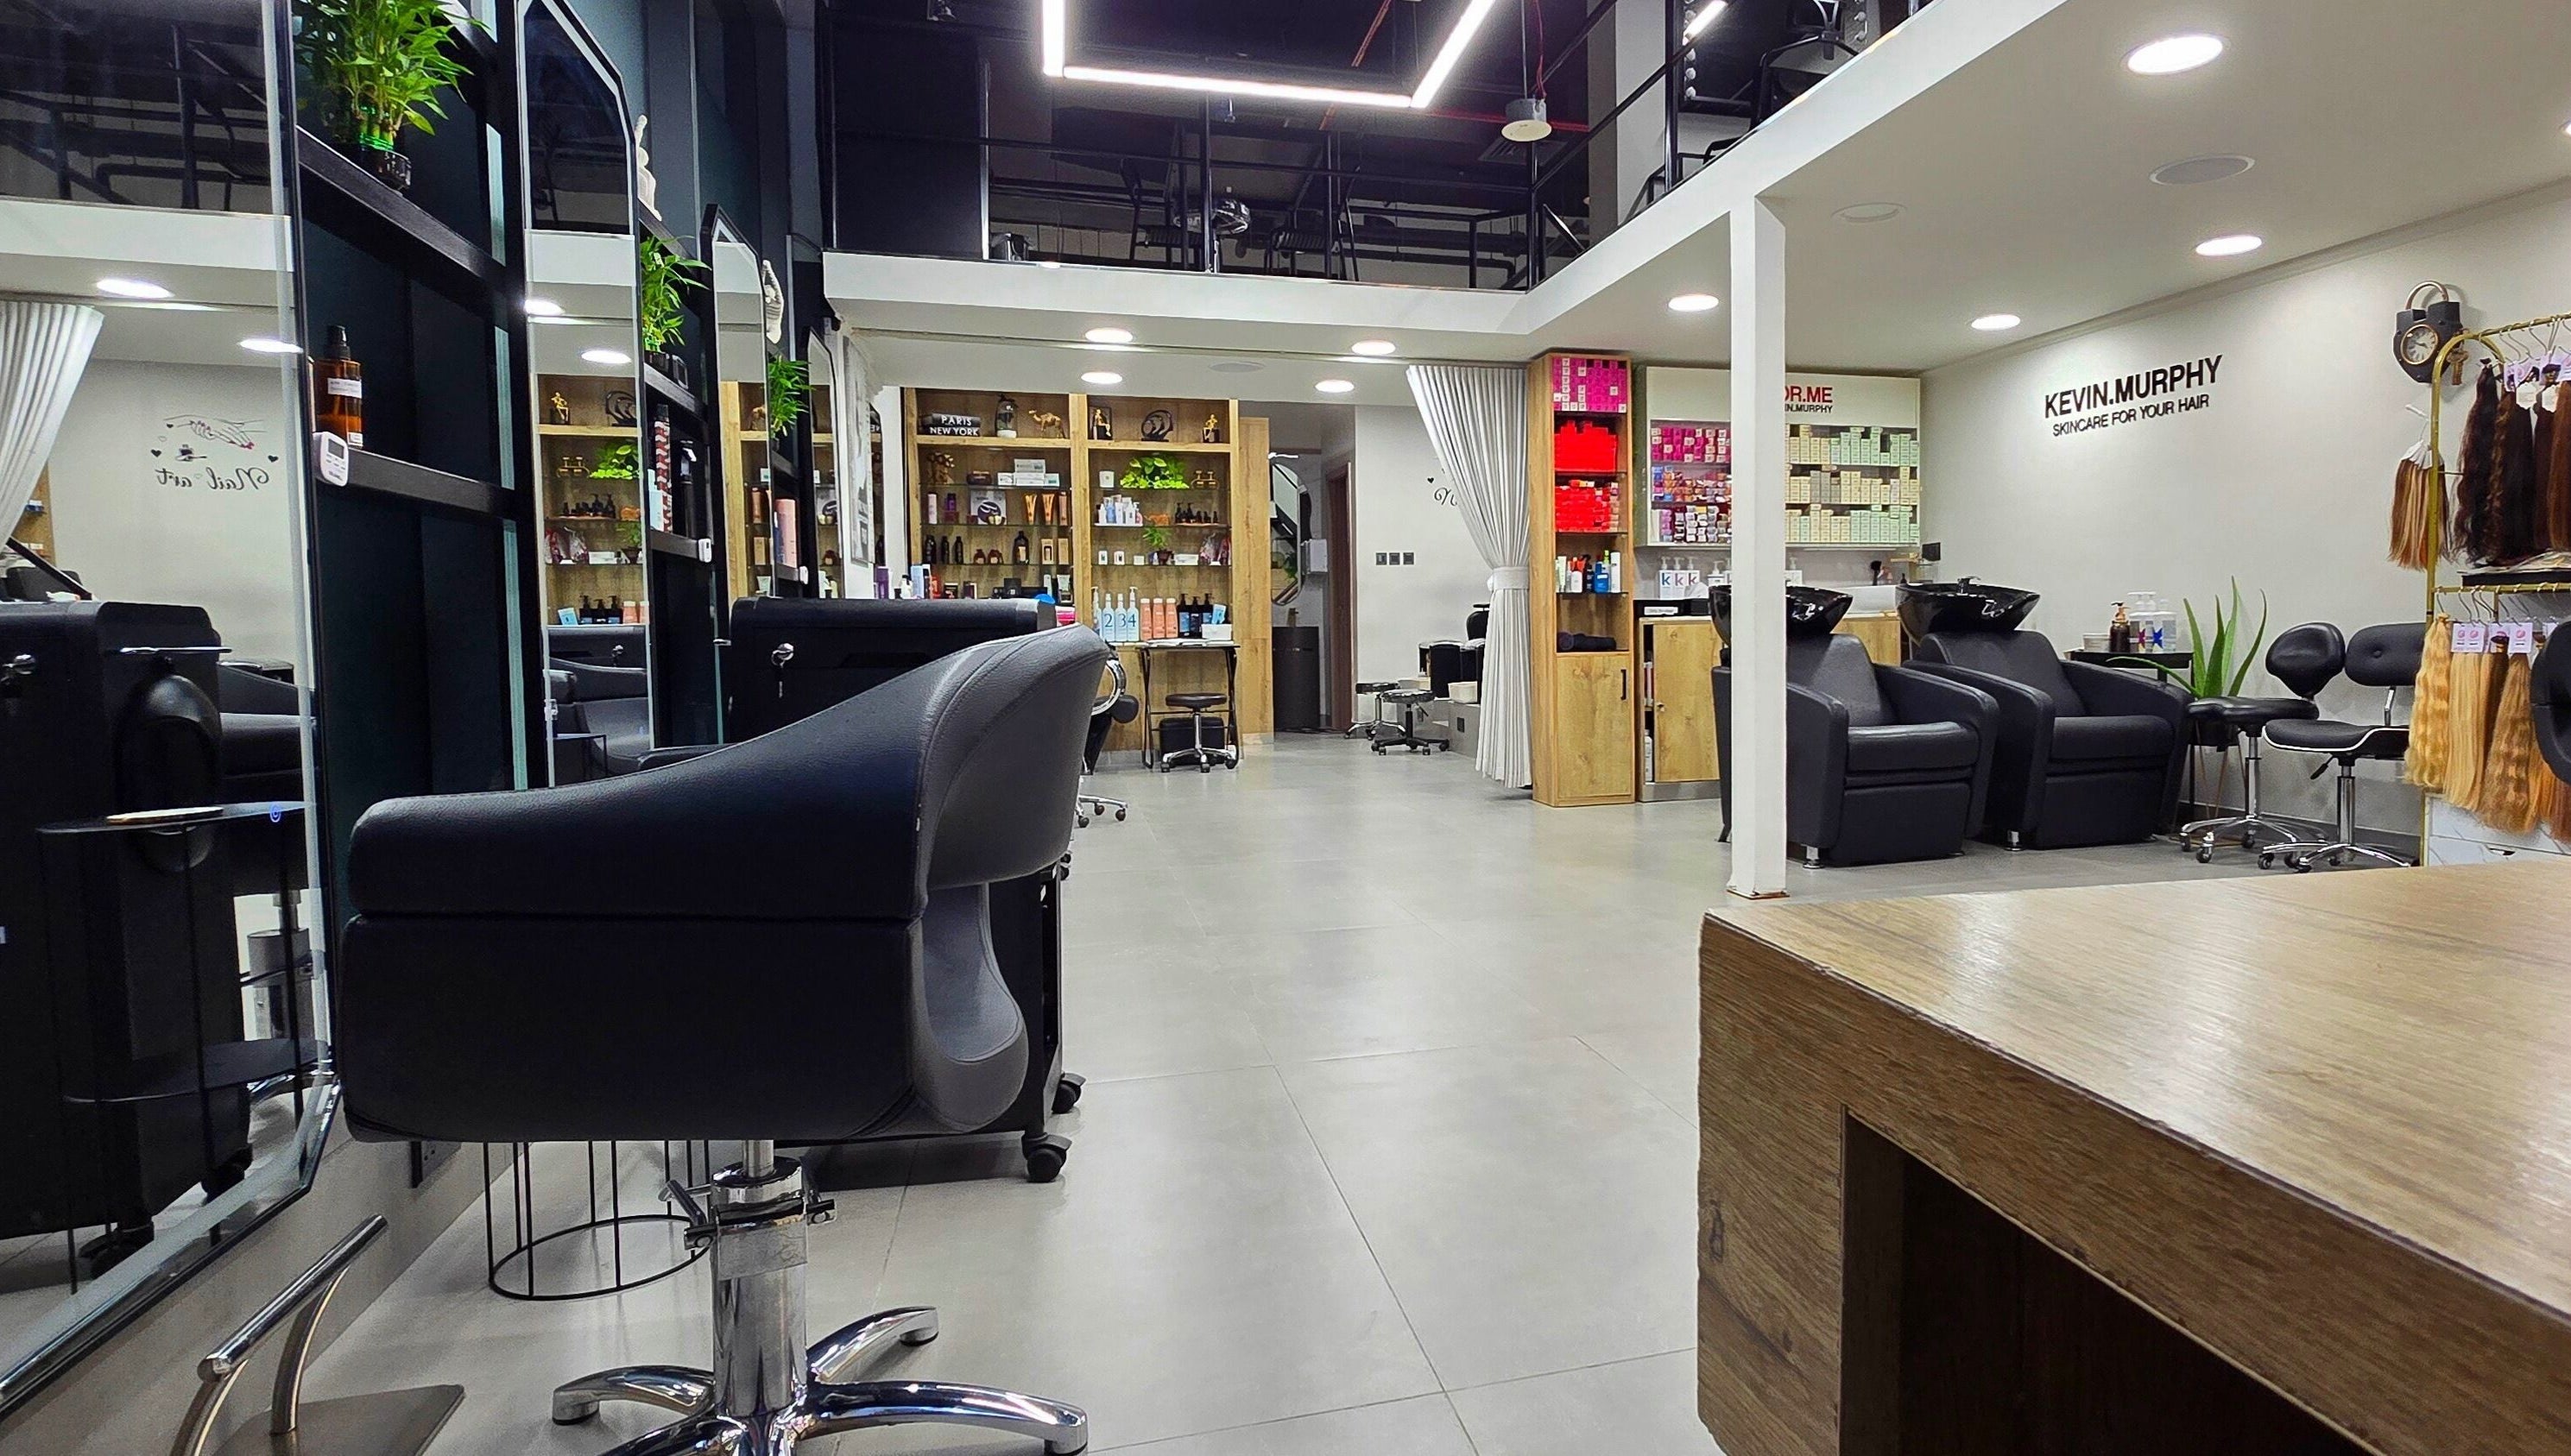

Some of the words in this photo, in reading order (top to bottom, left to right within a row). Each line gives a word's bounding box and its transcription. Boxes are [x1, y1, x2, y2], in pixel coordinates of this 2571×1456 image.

[2044, 354, 2223, 419] KEVIN.MURPHY
[1785, 403, 1833, 413] IN.MURPHY
[940, 414, 972, 426] PARIS
[2052, 413, 2108, 437] SKINCARE
[2112, 408, 2137, 425] FOR
[2139, 400, 2174, 419] YOUR
[2177, 394, 2210, 413] HAIR
[929, 426, 951, 435] NEW
[952, 427, 979, 436] YORK
[1661, 572, 1671, 586] k
[1675, 572, 1683, 586] k
[1103, 613, 1113, 627] 2
[1118, 613, 1127, 627] 3
[1128, 614, 1136, 627] 4
